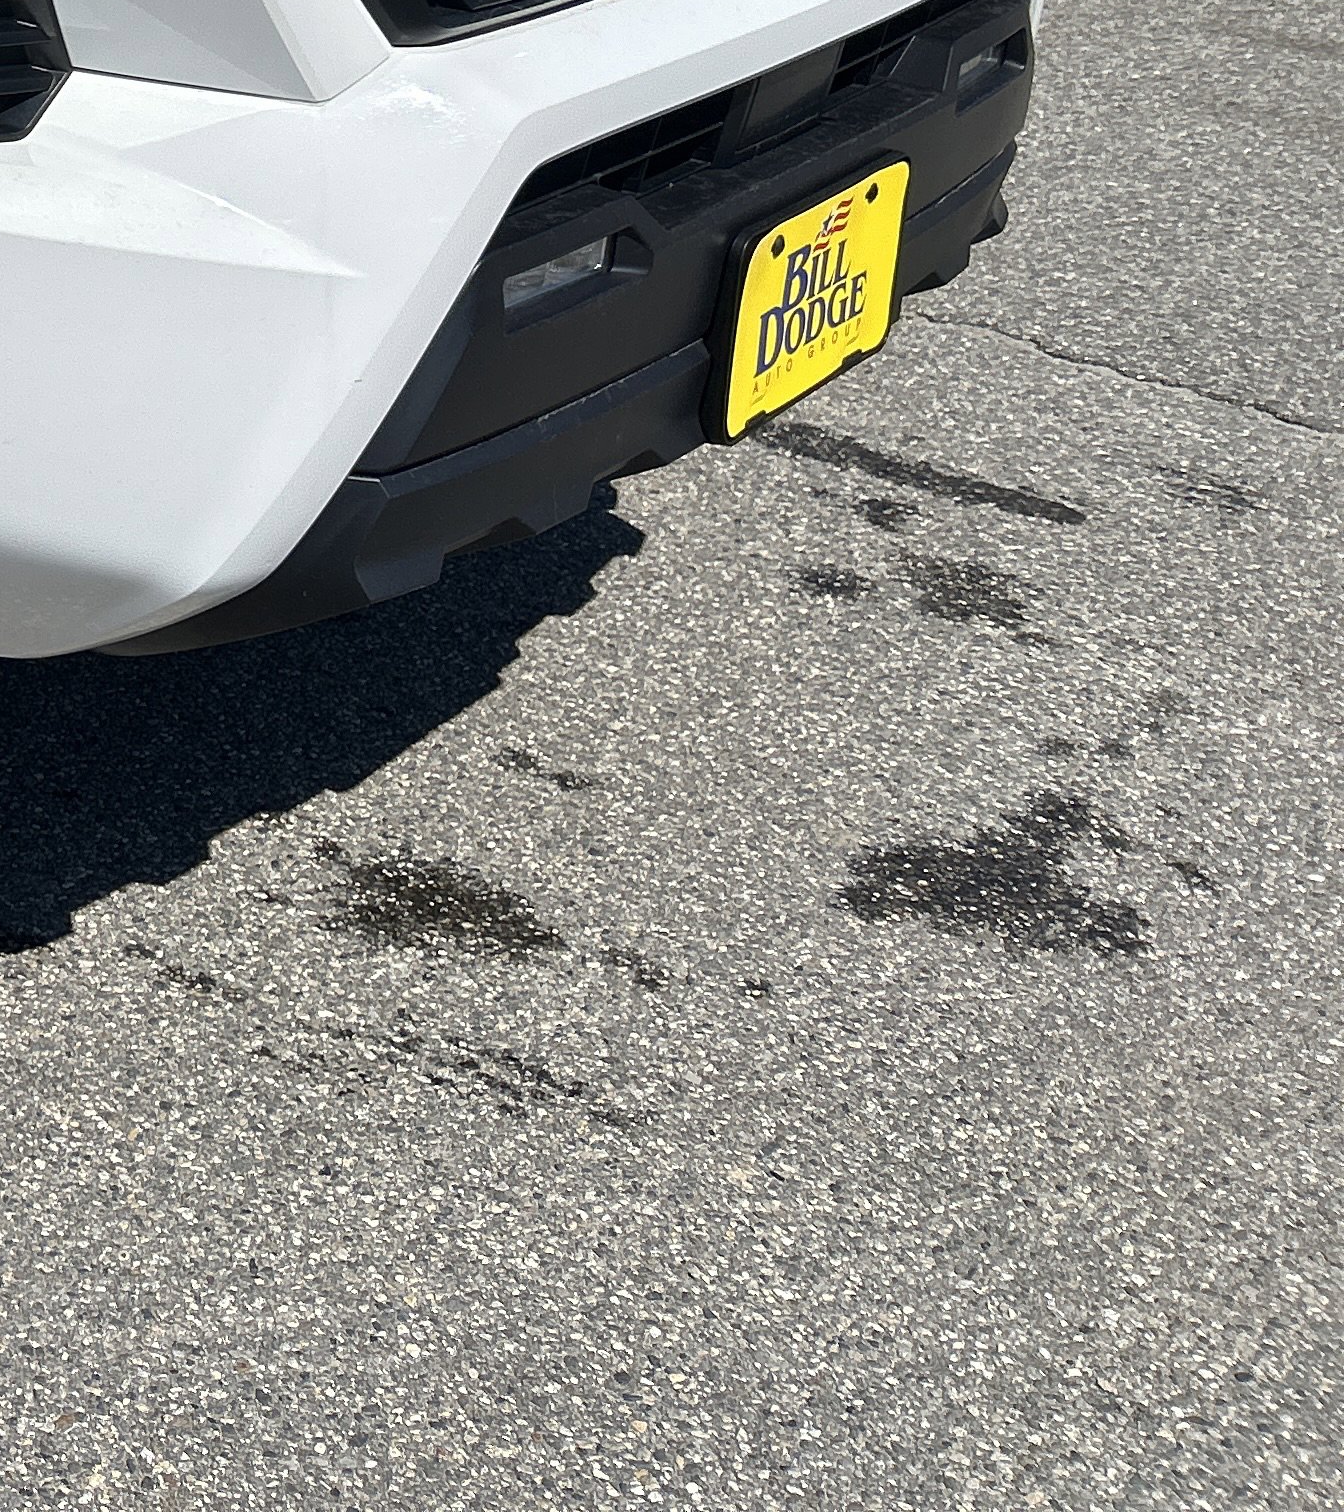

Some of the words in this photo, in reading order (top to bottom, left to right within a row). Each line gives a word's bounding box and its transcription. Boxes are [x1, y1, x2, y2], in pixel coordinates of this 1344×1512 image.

[782, 239, 852, 313] BILL
[752, 358, 793, 396] AUTO
[807, 317, 862, 359] GROUP
[753, 270, 867, 378] DODGE
